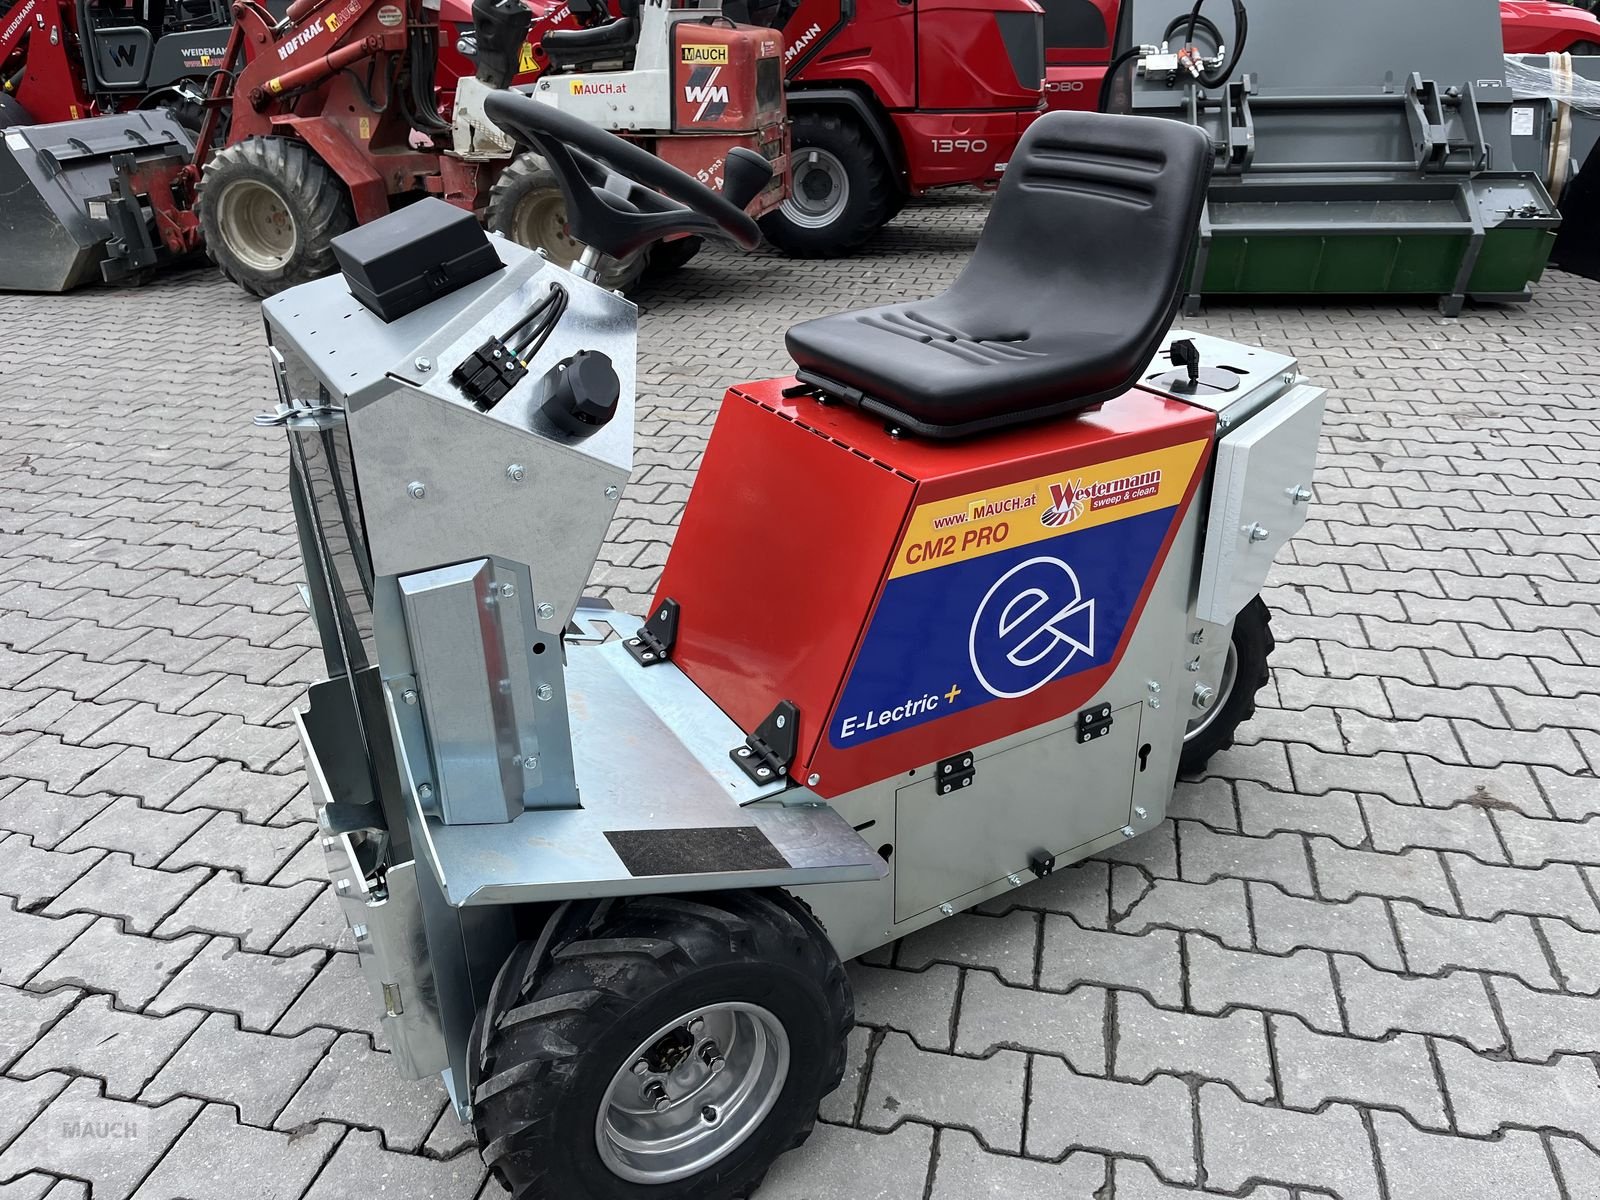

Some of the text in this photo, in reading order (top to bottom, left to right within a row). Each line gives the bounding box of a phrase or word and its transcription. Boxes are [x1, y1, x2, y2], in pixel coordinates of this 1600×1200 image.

[277, 17, 324, 60] HOFTRAC
[683, 47, 726, 60] MAUCH
[573, 83, 627, 95] MAUCH.at
[684, 86, 729, 103] WM
[931, 139, 987, 153] 1390
[1049, 470, 1161, 511] Westermann
[1093, 485, 1157, 508] sweep & clean.
[905, 522, 1009, 565] CM2 PRO
[840, 694, 939, 739] E-Lectric
